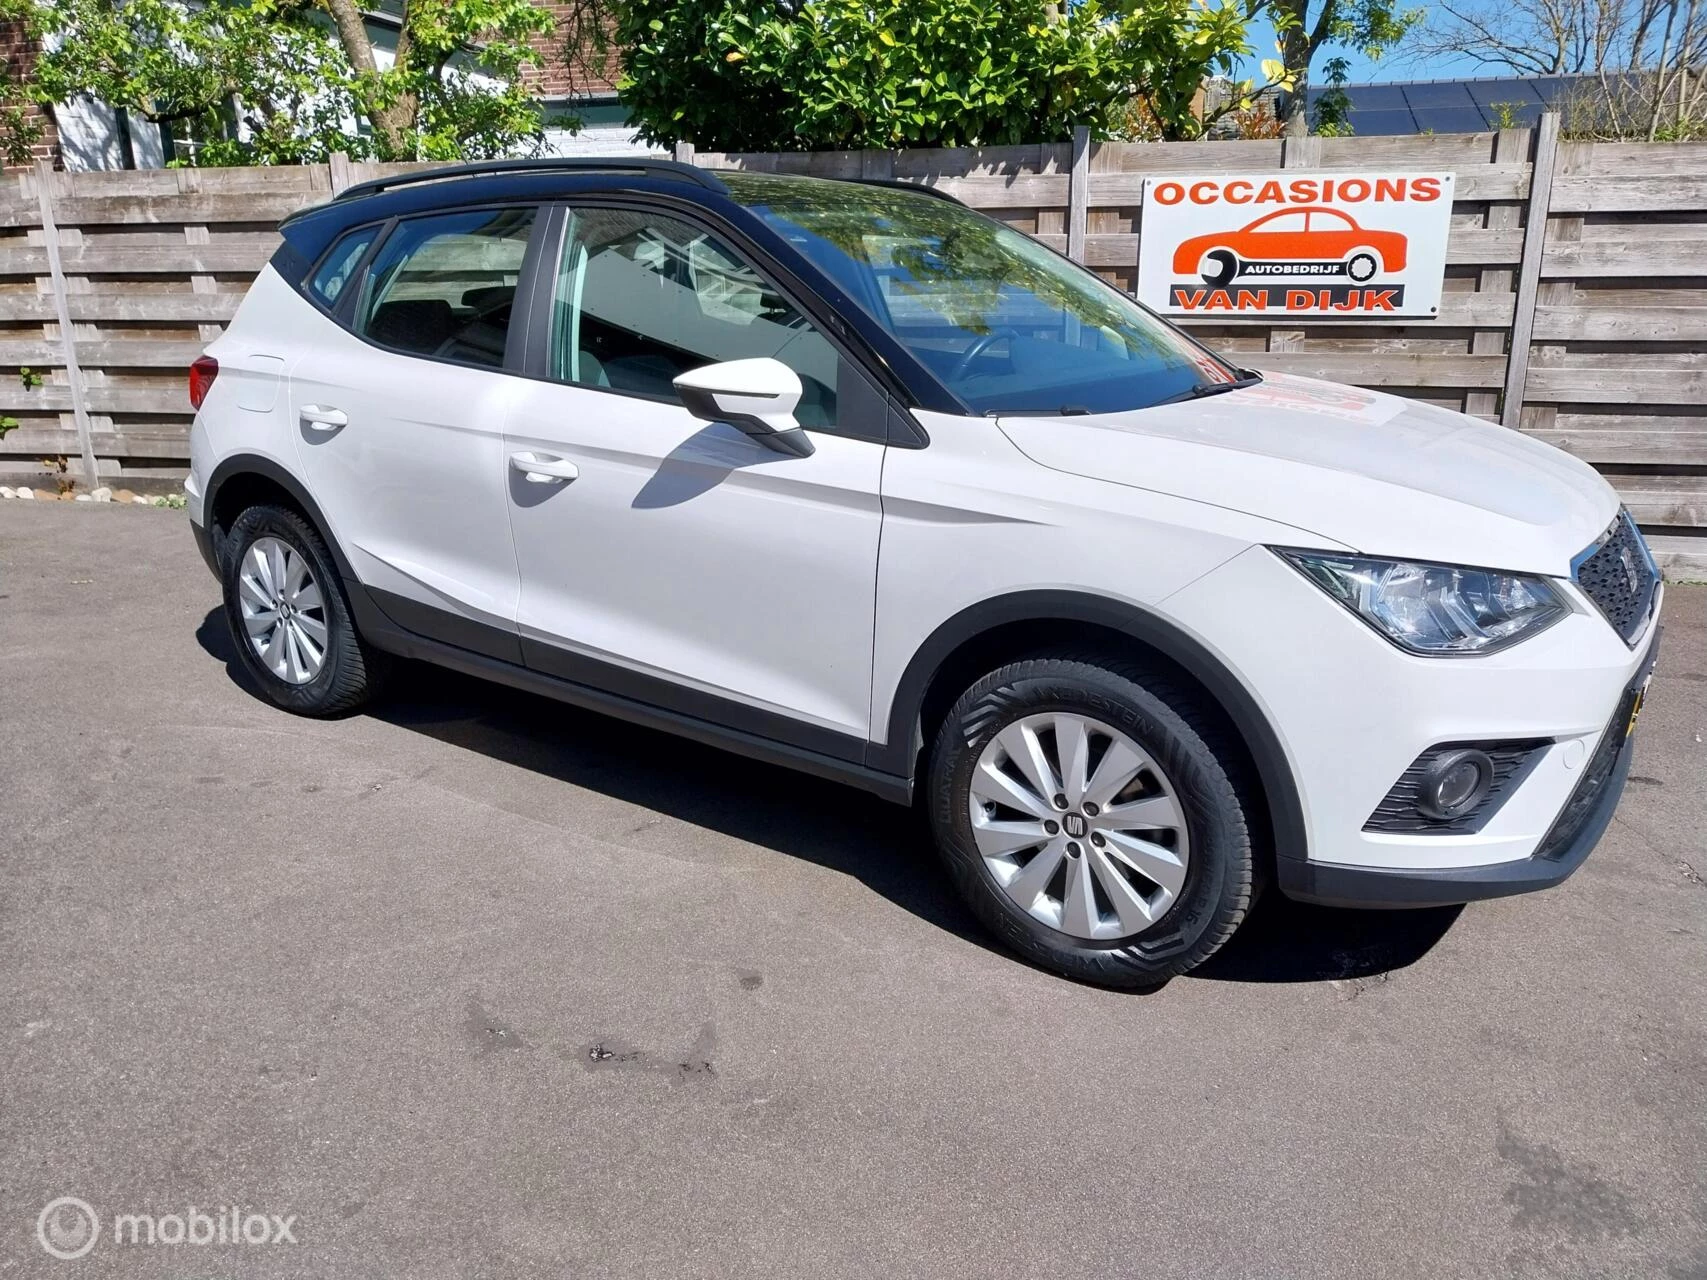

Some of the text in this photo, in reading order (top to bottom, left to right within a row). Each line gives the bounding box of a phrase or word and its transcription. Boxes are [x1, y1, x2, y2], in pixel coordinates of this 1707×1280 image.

[1153, 177, 1441, 206] OCCASIONS
[1245, 264, 1340, 275] AUTOBEDRIJF
[1175, 289, 1400, 312] VAN DIJK
